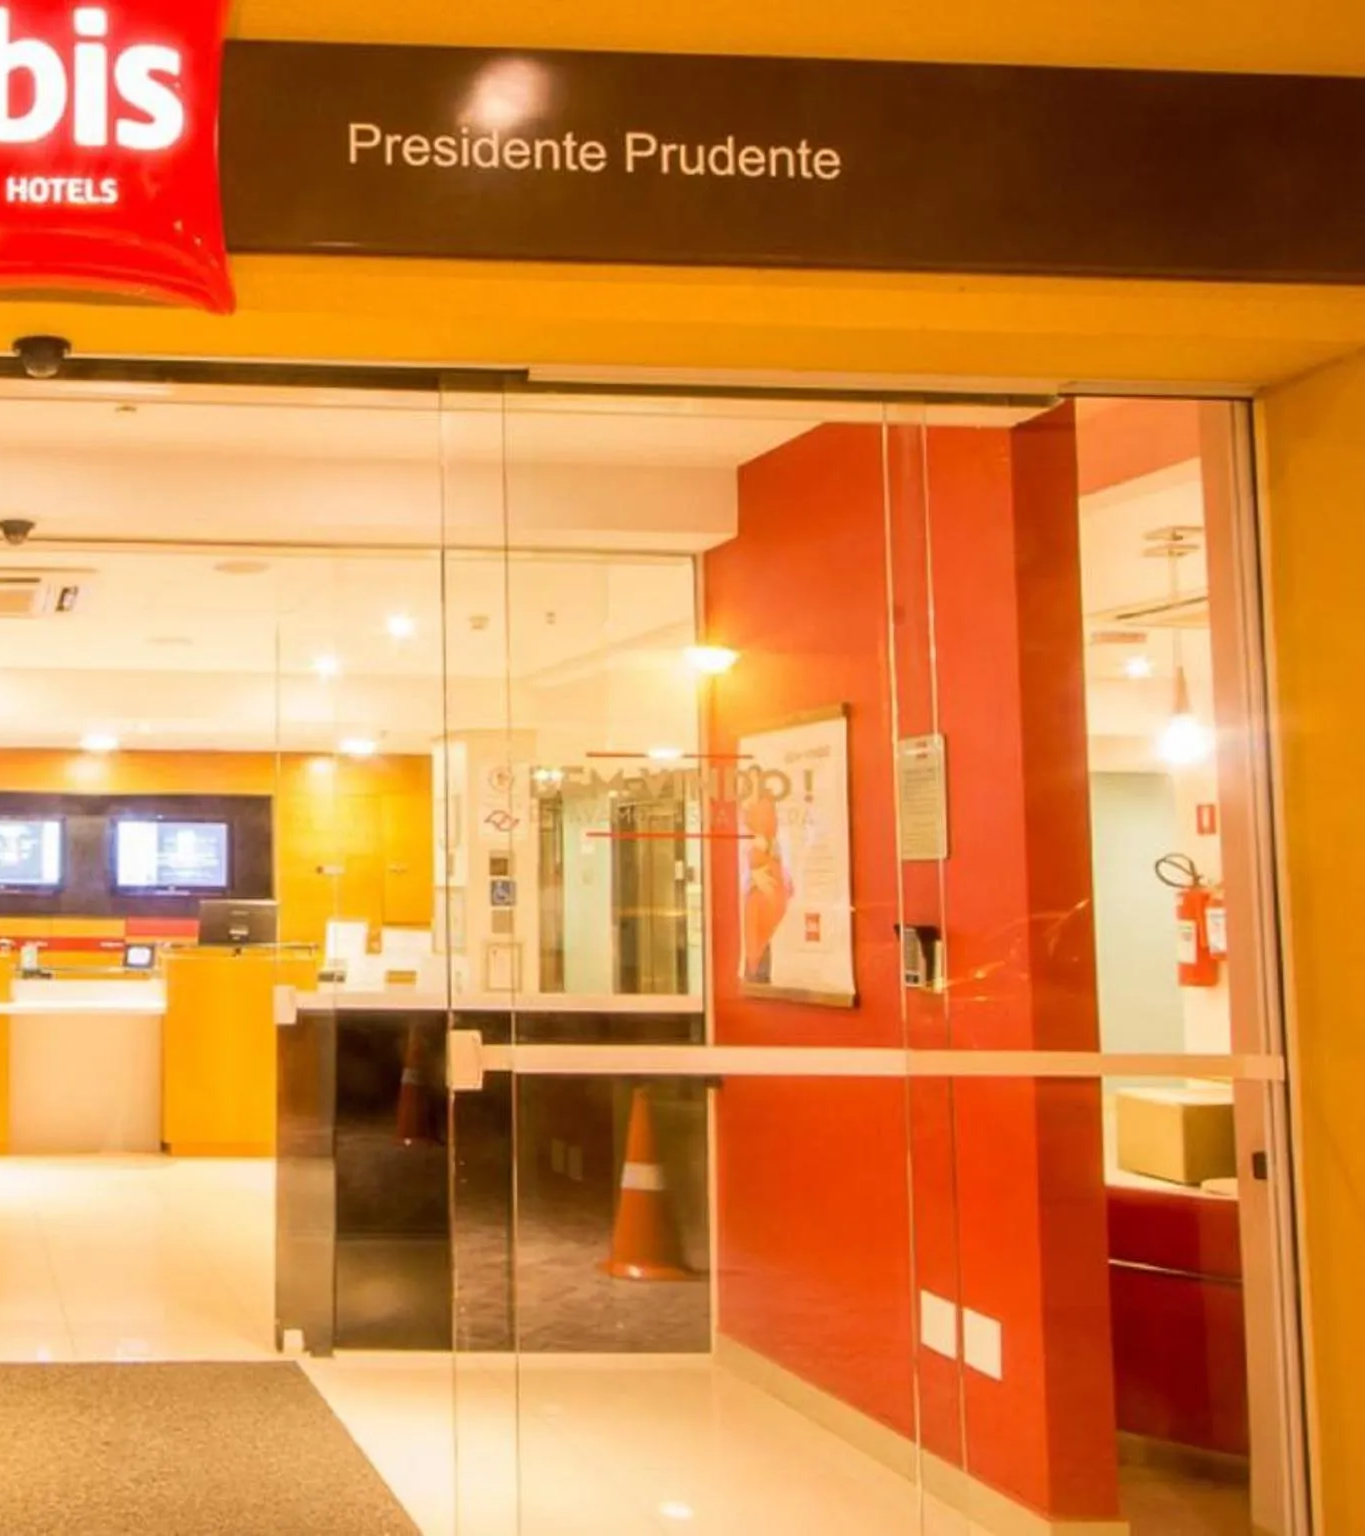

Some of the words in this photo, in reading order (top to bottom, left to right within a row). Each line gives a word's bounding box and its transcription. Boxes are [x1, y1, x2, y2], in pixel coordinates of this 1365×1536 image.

[347, 122, 607, 173] Presidente
[624, 132, 842, 180] Prudente
[5, 175, 120, 205] HOTELS
